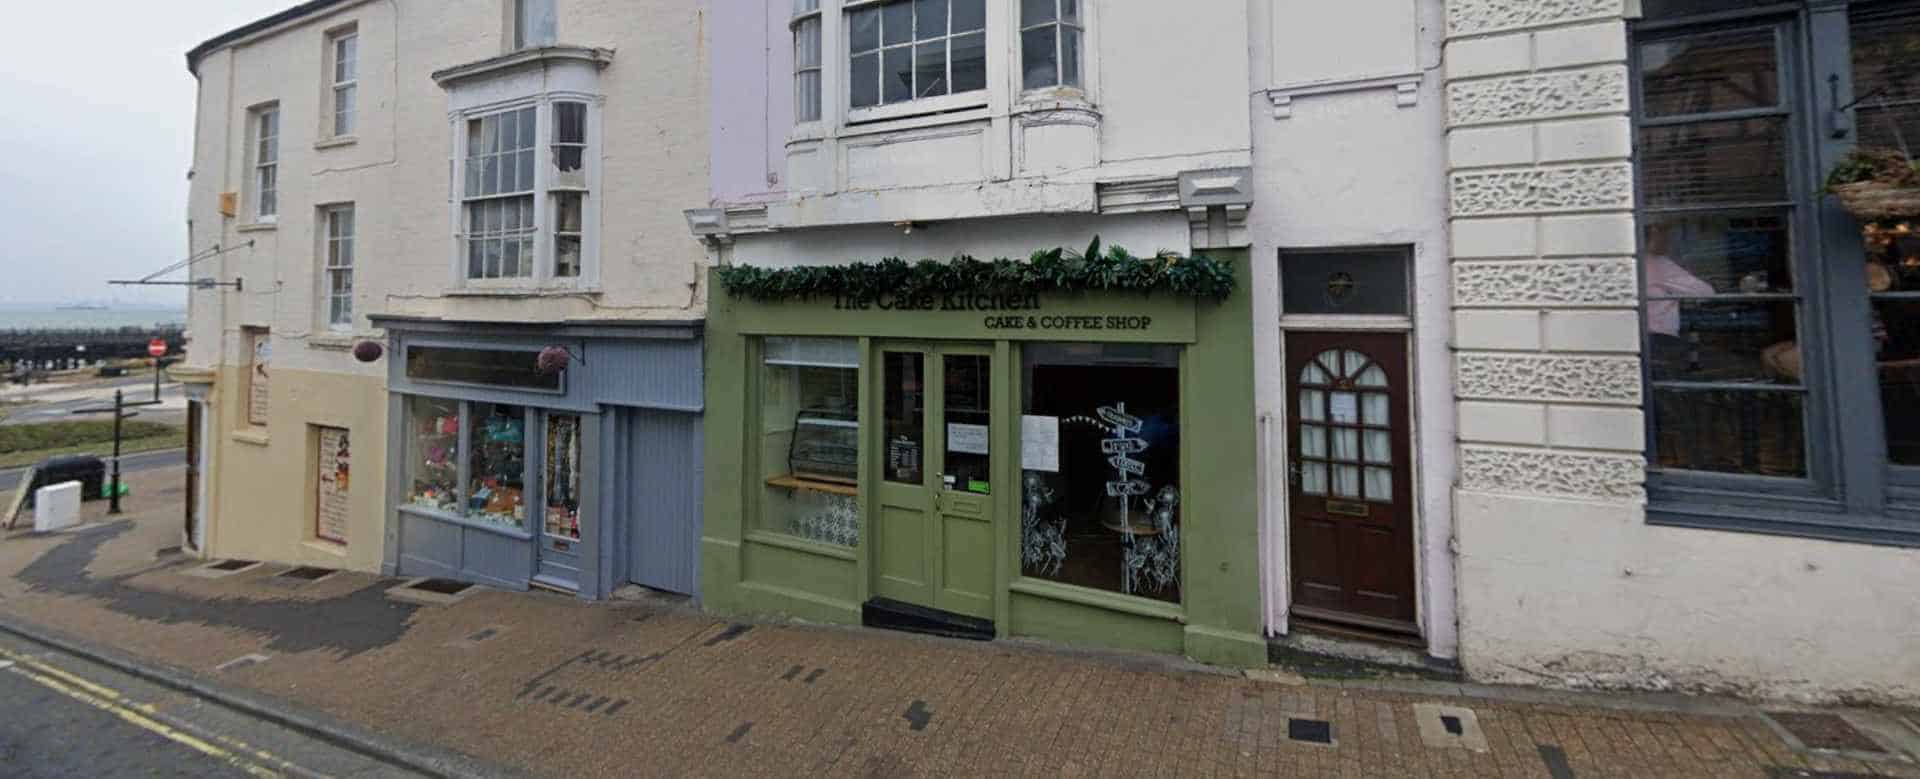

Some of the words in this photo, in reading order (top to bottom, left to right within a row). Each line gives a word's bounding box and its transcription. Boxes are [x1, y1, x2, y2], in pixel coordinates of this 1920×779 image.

[832, 287, 871, 310] The
[876, 287, 936, 310] Cake
[941, 286, 1042, 310] Kitchen
[984, 316, 1023, 329] CAKE
[1026, 316, 1037, 329] &
[1040, 316, 1103, 329] COFFEE
[1106, 316, 1152, 329] SHOP
